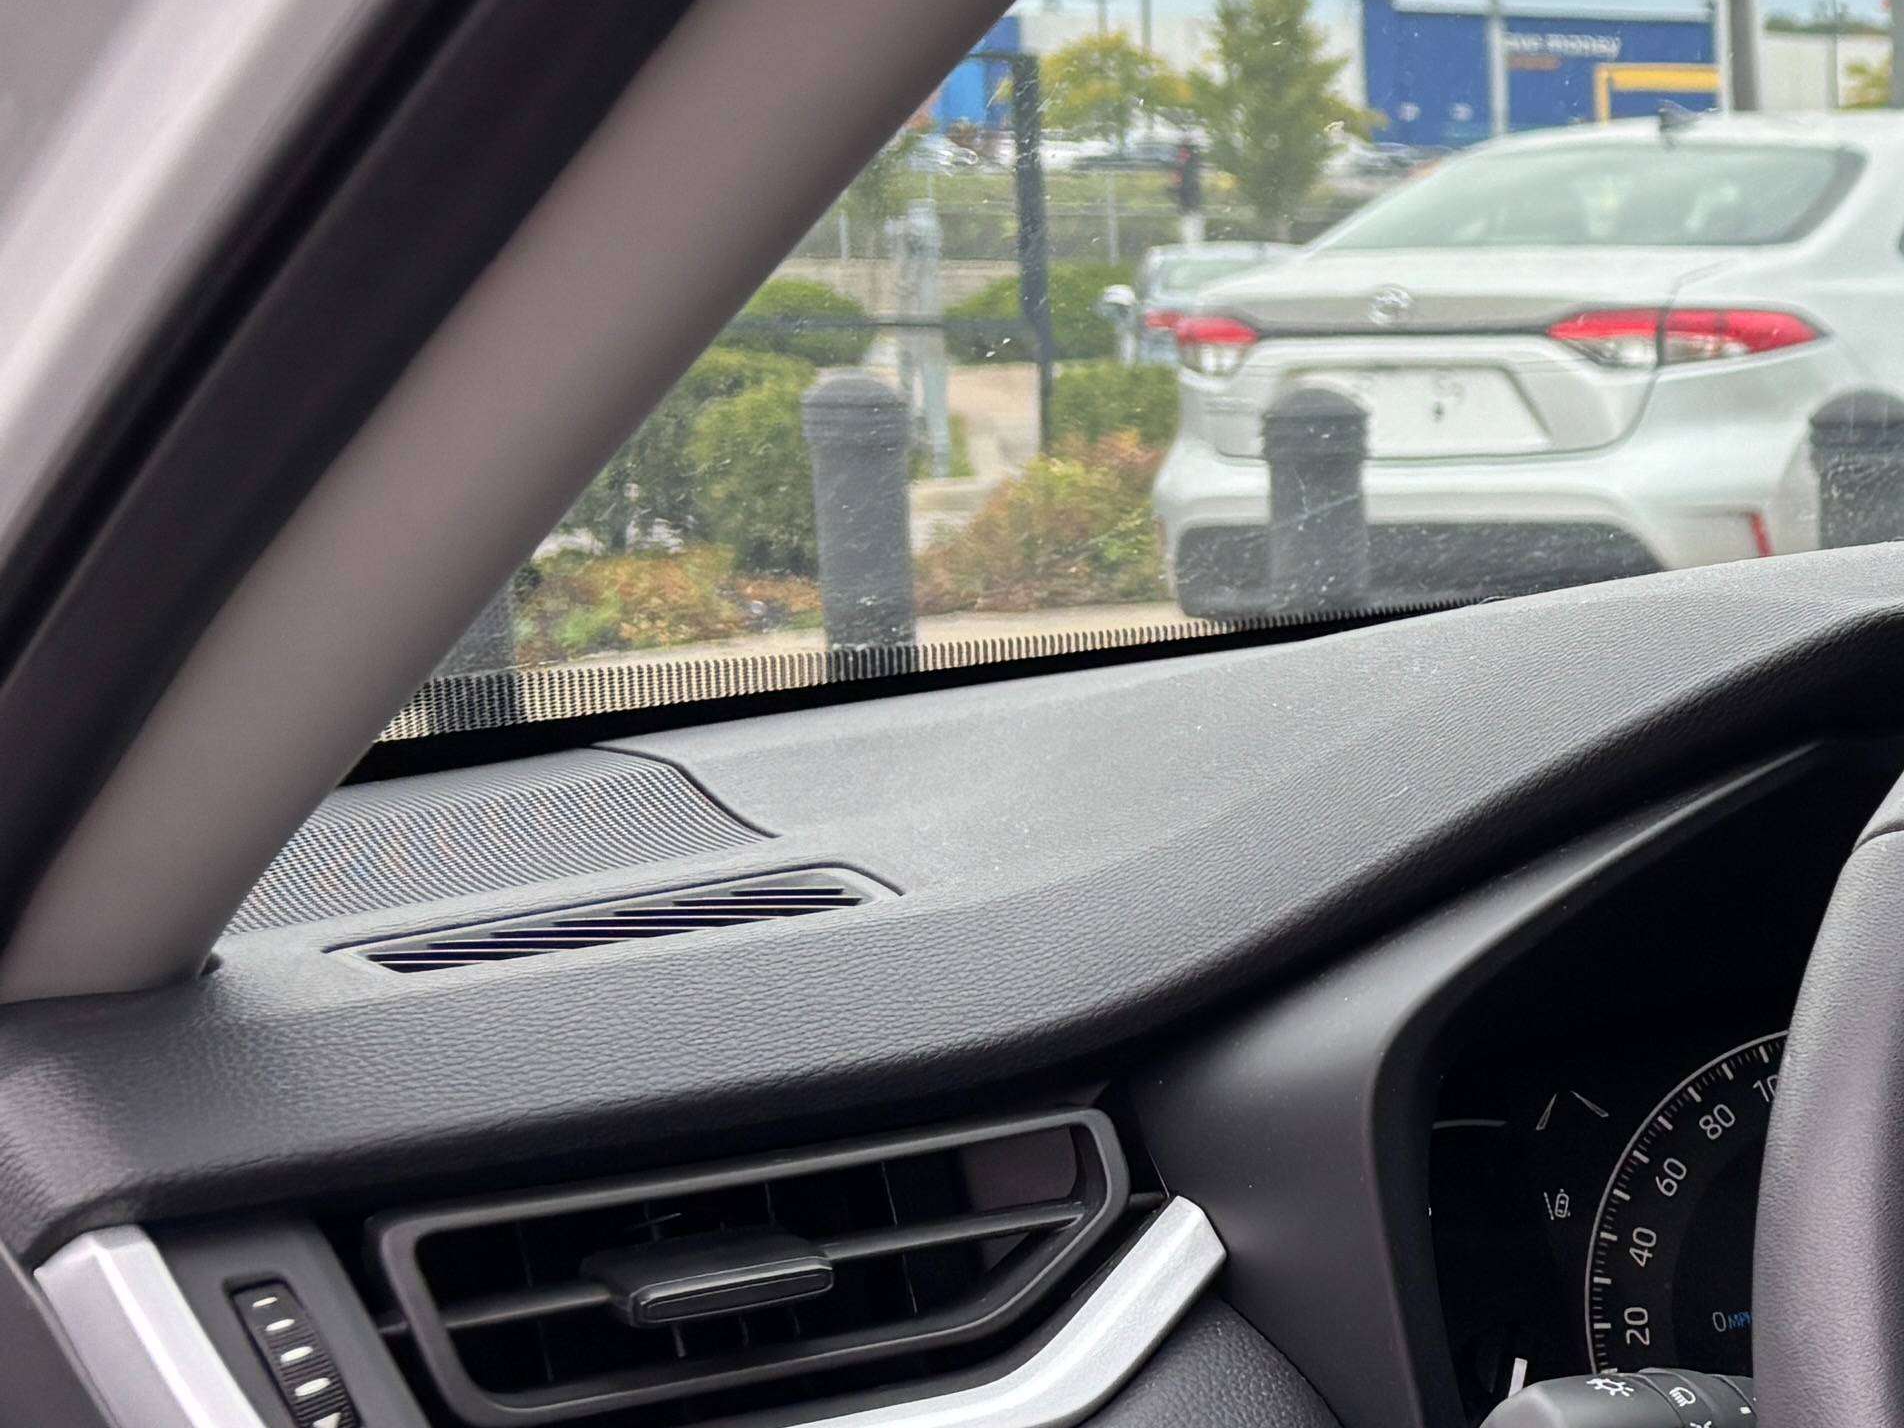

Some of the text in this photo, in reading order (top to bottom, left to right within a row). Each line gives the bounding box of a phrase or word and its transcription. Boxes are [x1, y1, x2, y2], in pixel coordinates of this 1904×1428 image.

[1698, 1103, 1736, 1140] 80
[1655, 1157, 1687, 1197] 60
[1629, 1226, 1657, 1268] 40
[1623, 1306, 1651, 1347] 20
